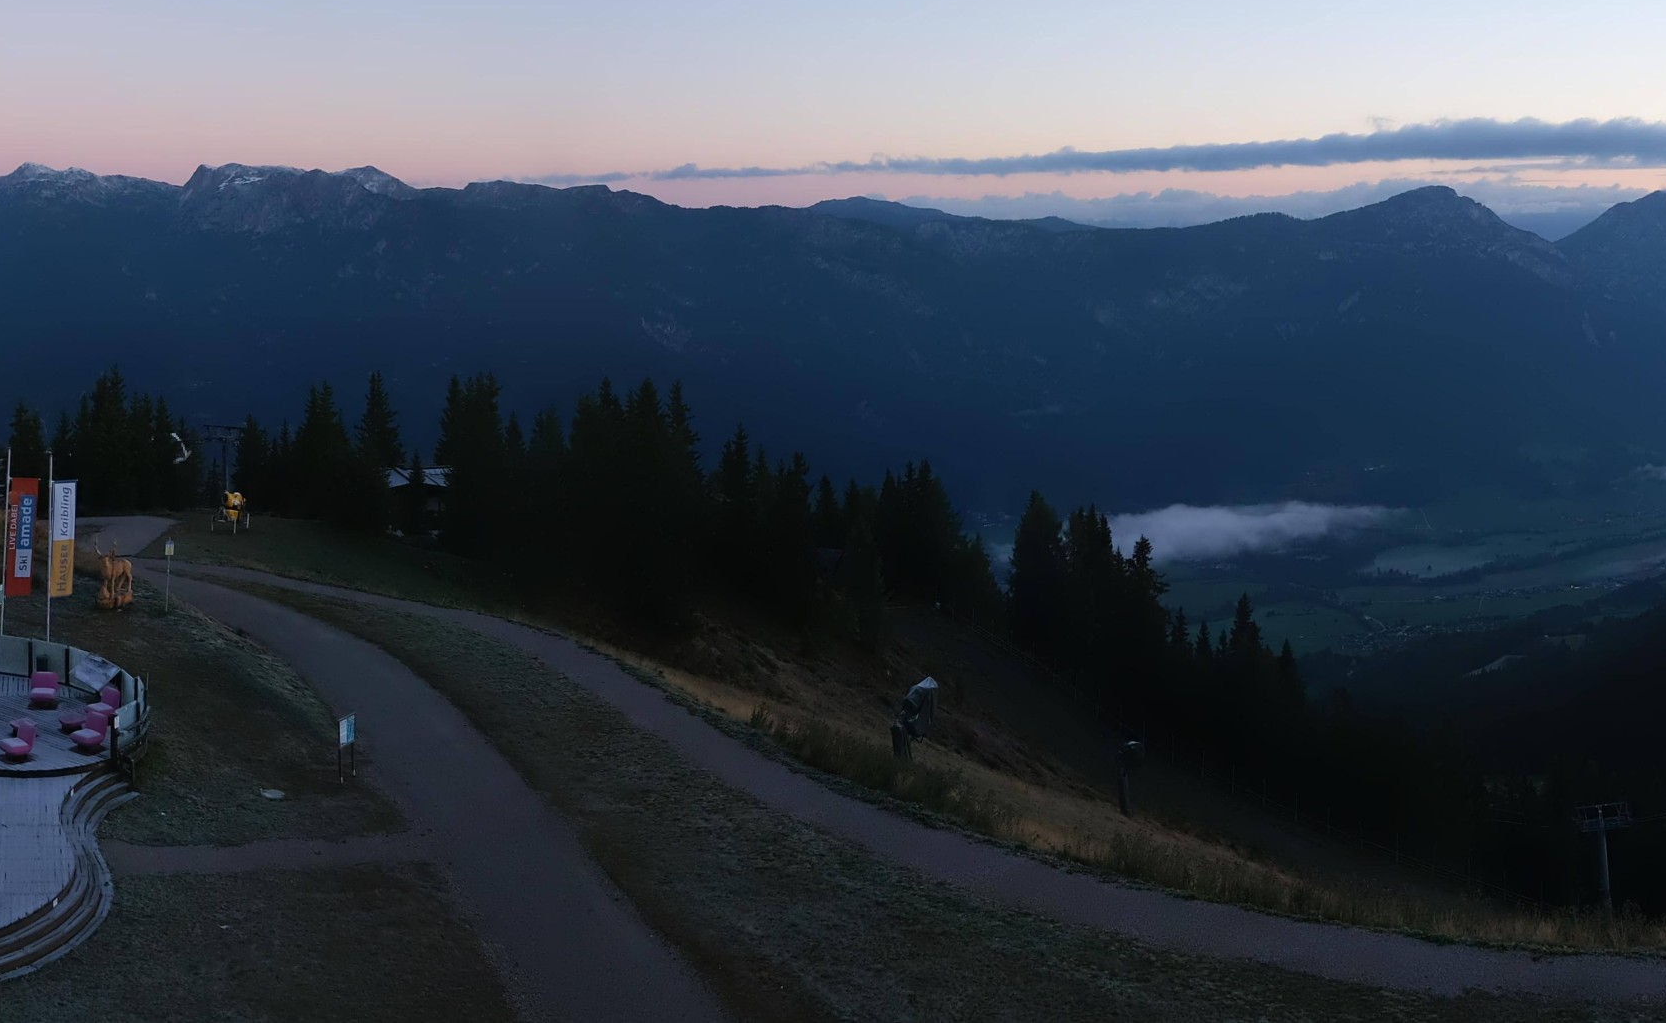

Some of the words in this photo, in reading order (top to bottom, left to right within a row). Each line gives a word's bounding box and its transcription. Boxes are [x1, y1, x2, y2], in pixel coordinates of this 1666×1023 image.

[10, 504, 18, 530] DABEI
[60, 486, 73, 537] Kaibling
[8, 531, 16, 550] LIVE
[19, 550, 28, 571] Ski
[57, 544, 68, 592] HAUSER
